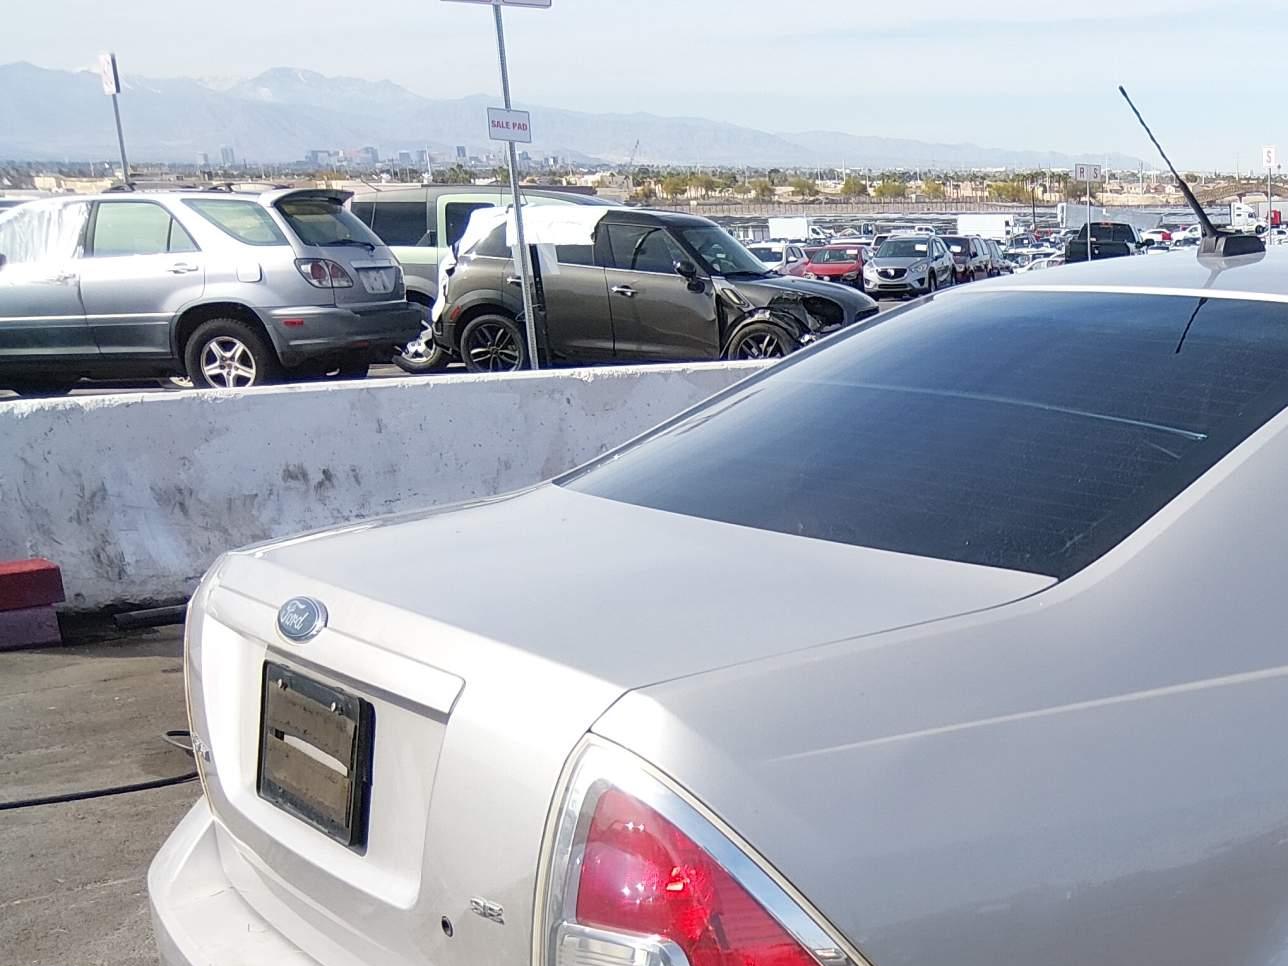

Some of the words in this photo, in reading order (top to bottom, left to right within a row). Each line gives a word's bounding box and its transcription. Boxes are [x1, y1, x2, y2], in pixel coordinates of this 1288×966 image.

[491, 119, 512, 130] SALE
[512, 121, 528, 132] PAD
[1266, 150, 1272, 163] S
[1079, 167, 1085, 178] R
[1093, 167, 1098, 178] S
[280, 599, 311, 631] Ford
